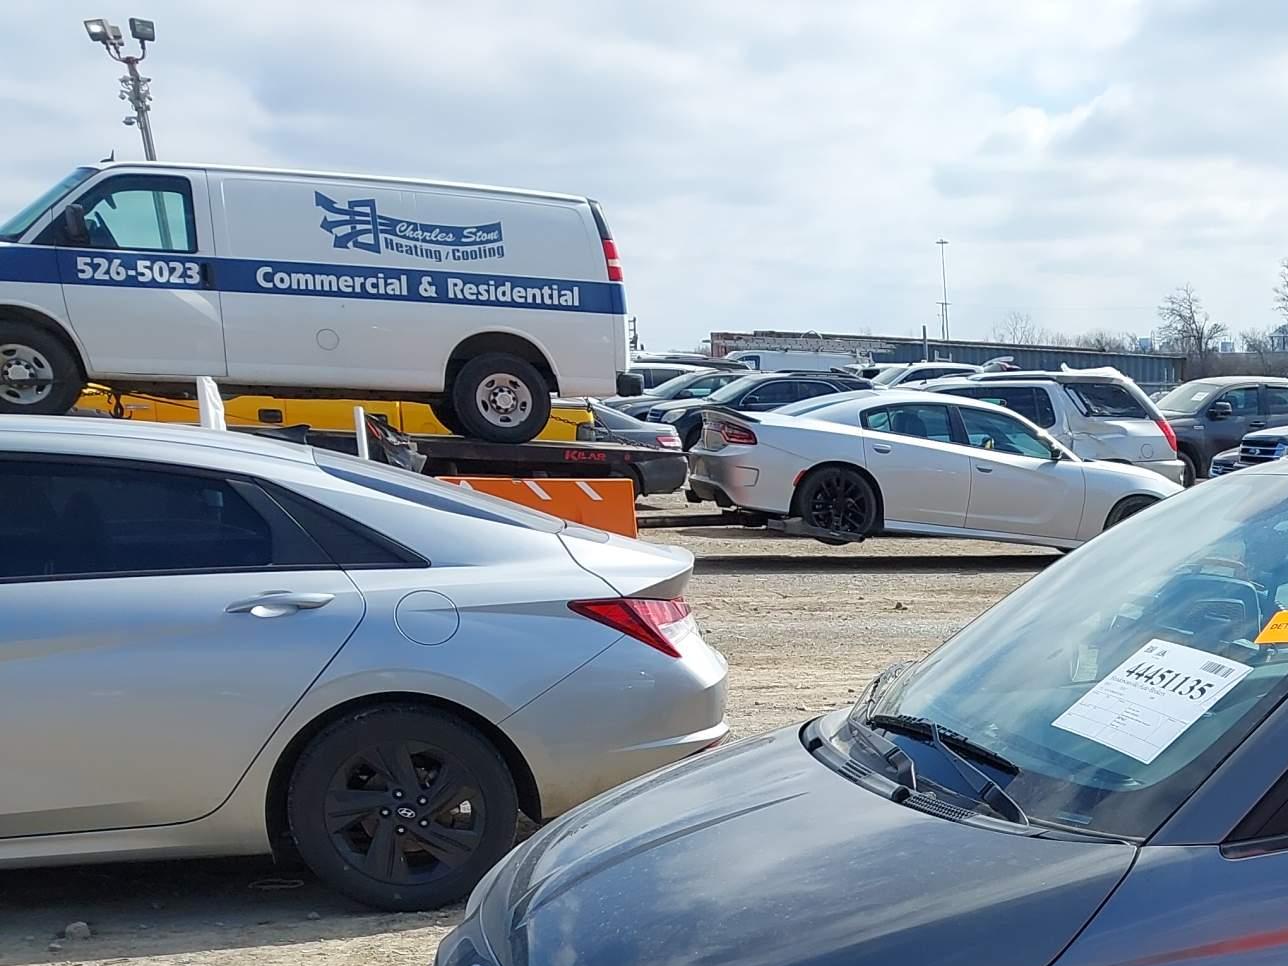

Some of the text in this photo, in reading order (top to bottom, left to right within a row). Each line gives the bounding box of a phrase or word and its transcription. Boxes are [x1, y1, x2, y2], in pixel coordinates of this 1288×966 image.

[395, 222, 456, 242] Charles
[383, 236, 442, 262] Heating
[452, 244, 505, 261] Cooling
[76, 256, 201, 284] 526-5023
[255, 266, 580, 306] Commercial & Residential
[1125, 661, 1215, 700] 44451135
